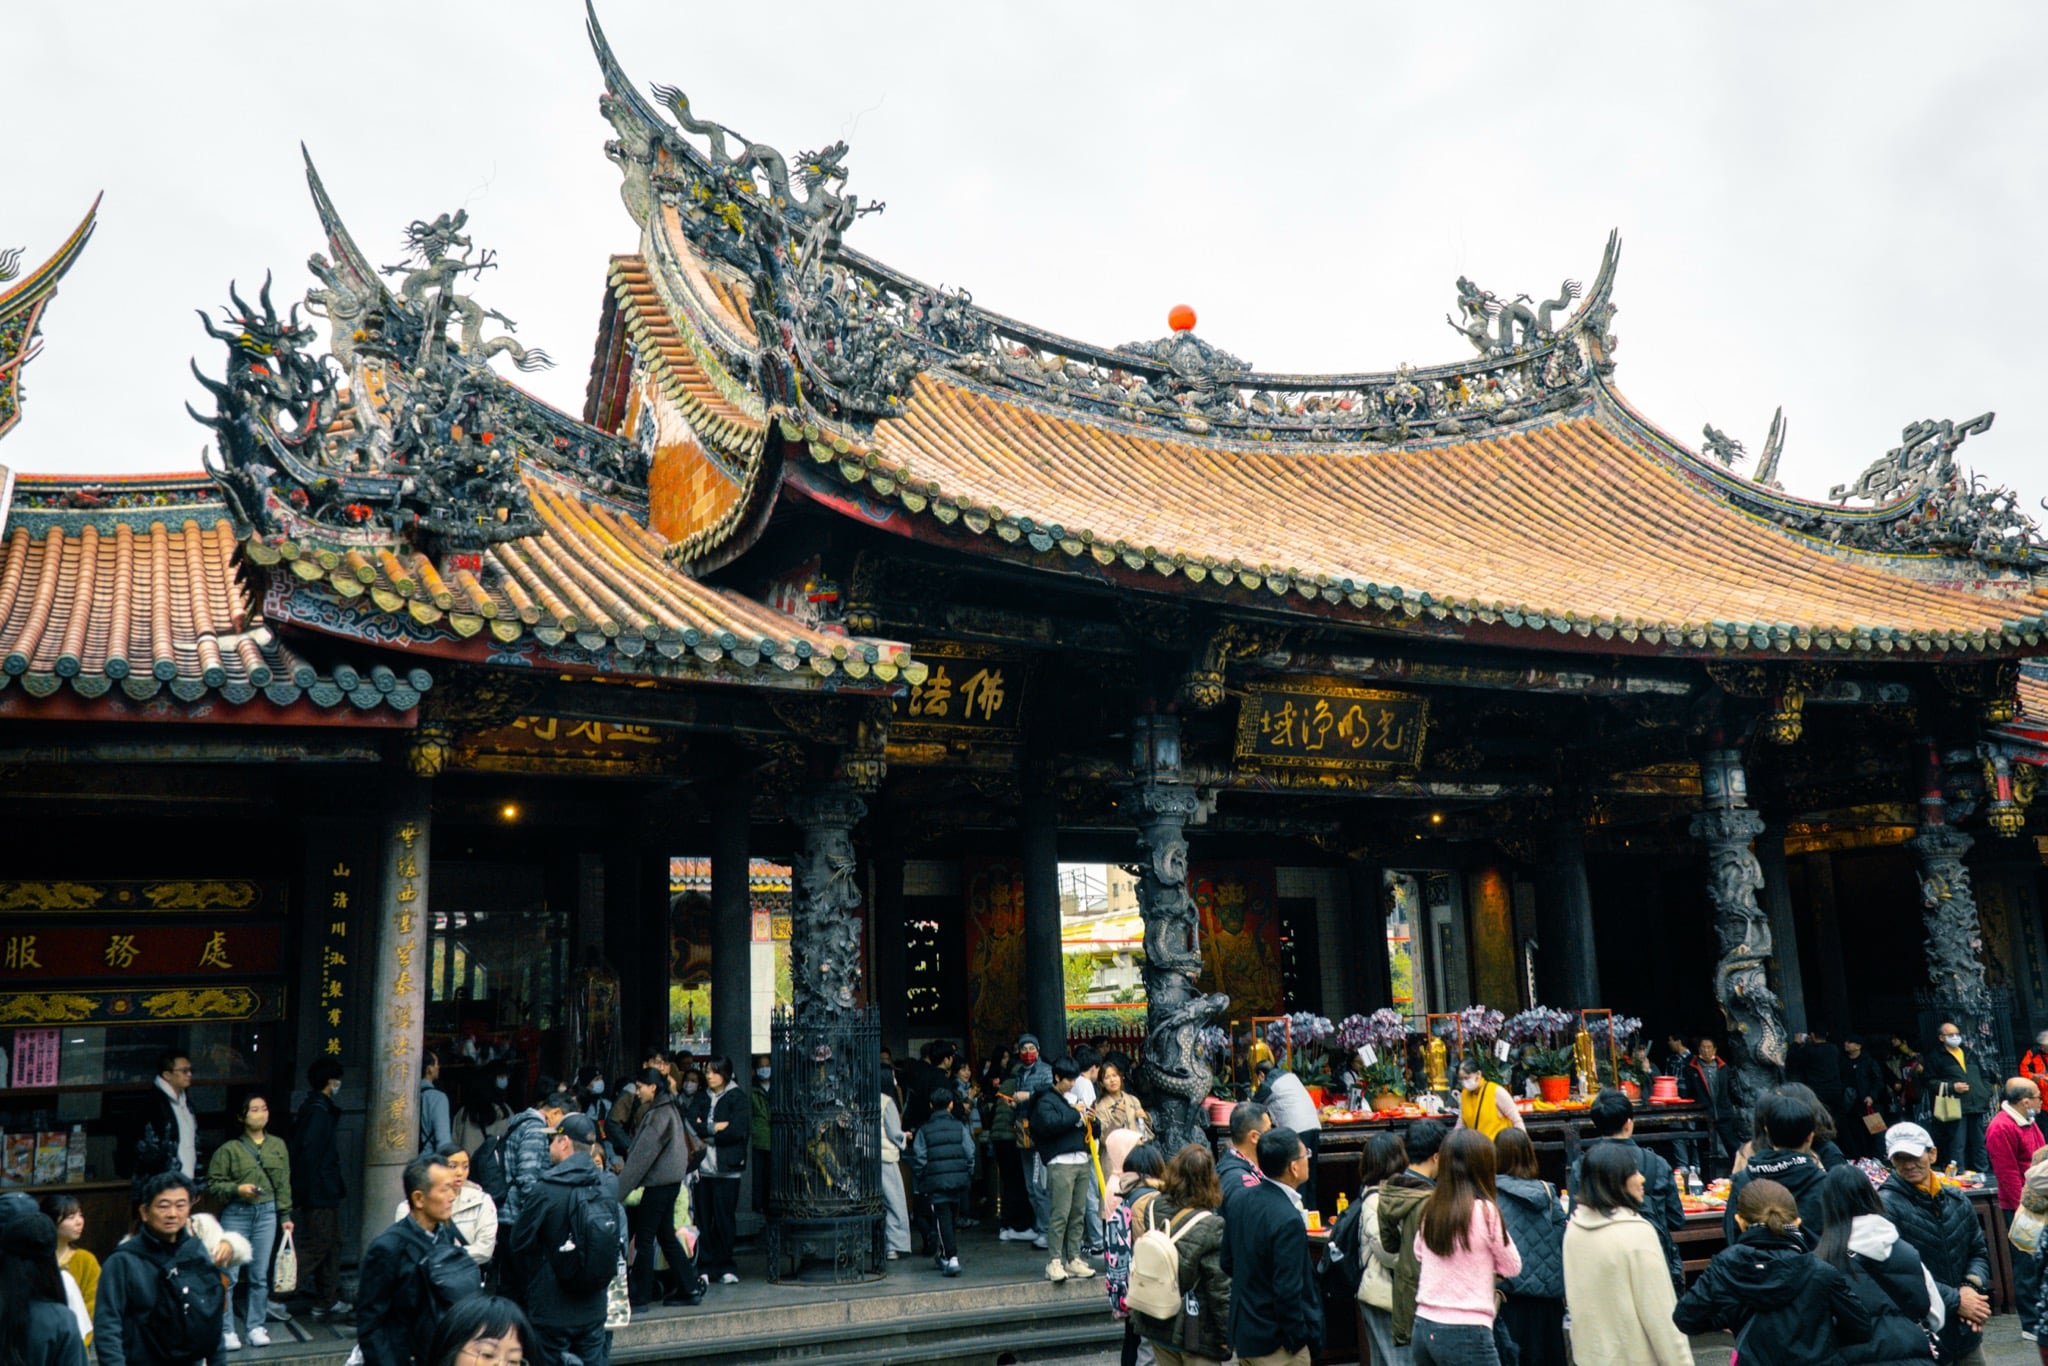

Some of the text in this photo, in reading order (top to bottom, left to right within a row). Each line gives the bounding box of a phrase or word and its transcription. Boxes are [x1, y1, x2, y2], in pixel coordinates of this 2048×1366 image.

[893, 665, 1004, 721] 佛法
[1260, 699, 1403, 750] 光明淨域
[5, 930, 233, 969] 服務處
